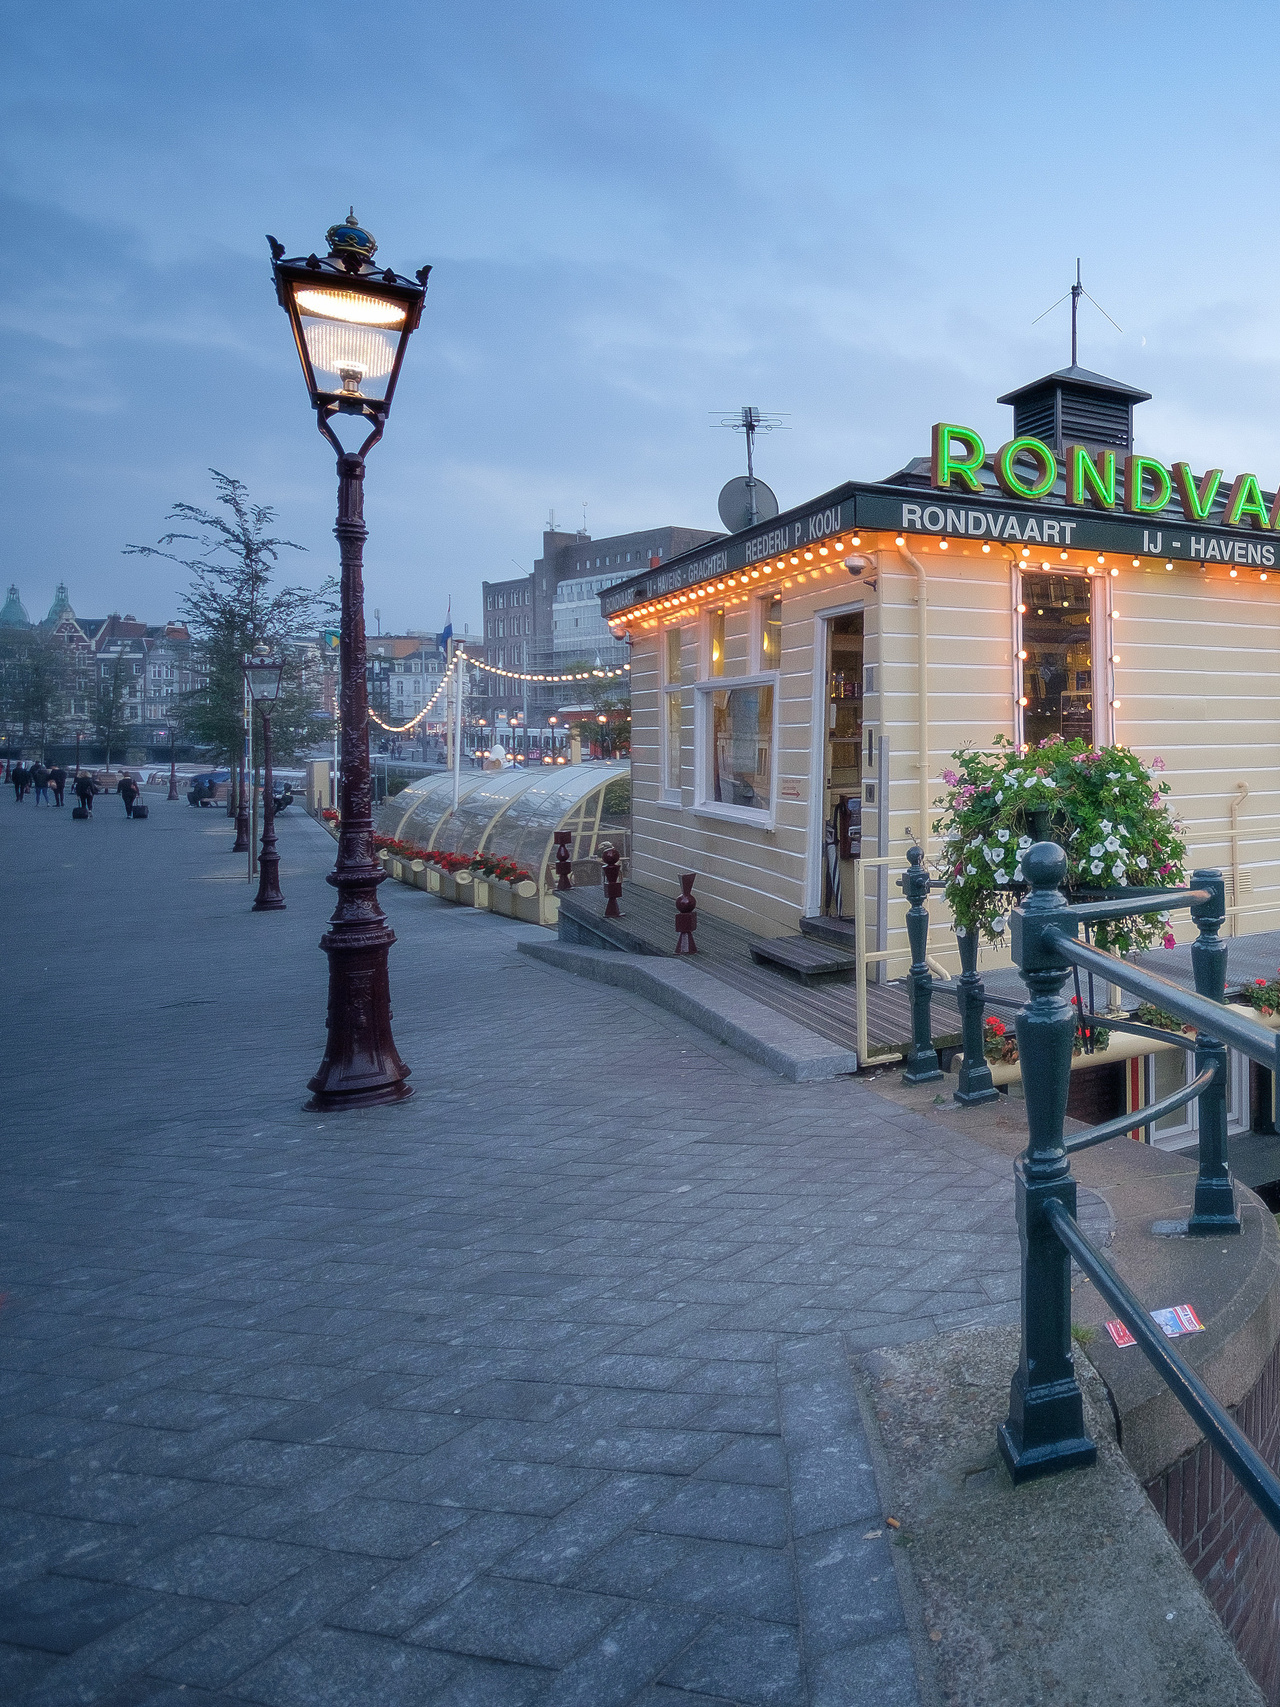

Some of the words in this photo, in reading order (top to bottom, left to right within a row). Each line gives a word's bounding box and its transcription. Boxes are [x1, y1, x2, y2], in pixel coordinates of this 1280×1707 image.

[745, 529, 789, 563] REEDERIJ
[809, 506, 841, 539] KOOIJ
[901, 503, 1076, 544] RONDVAART
[688, 551, 728, 583] GRACHTEN
[1143, 530, 1162, 553] IJ
[1190, 537, 1275, 567] HAVENS
